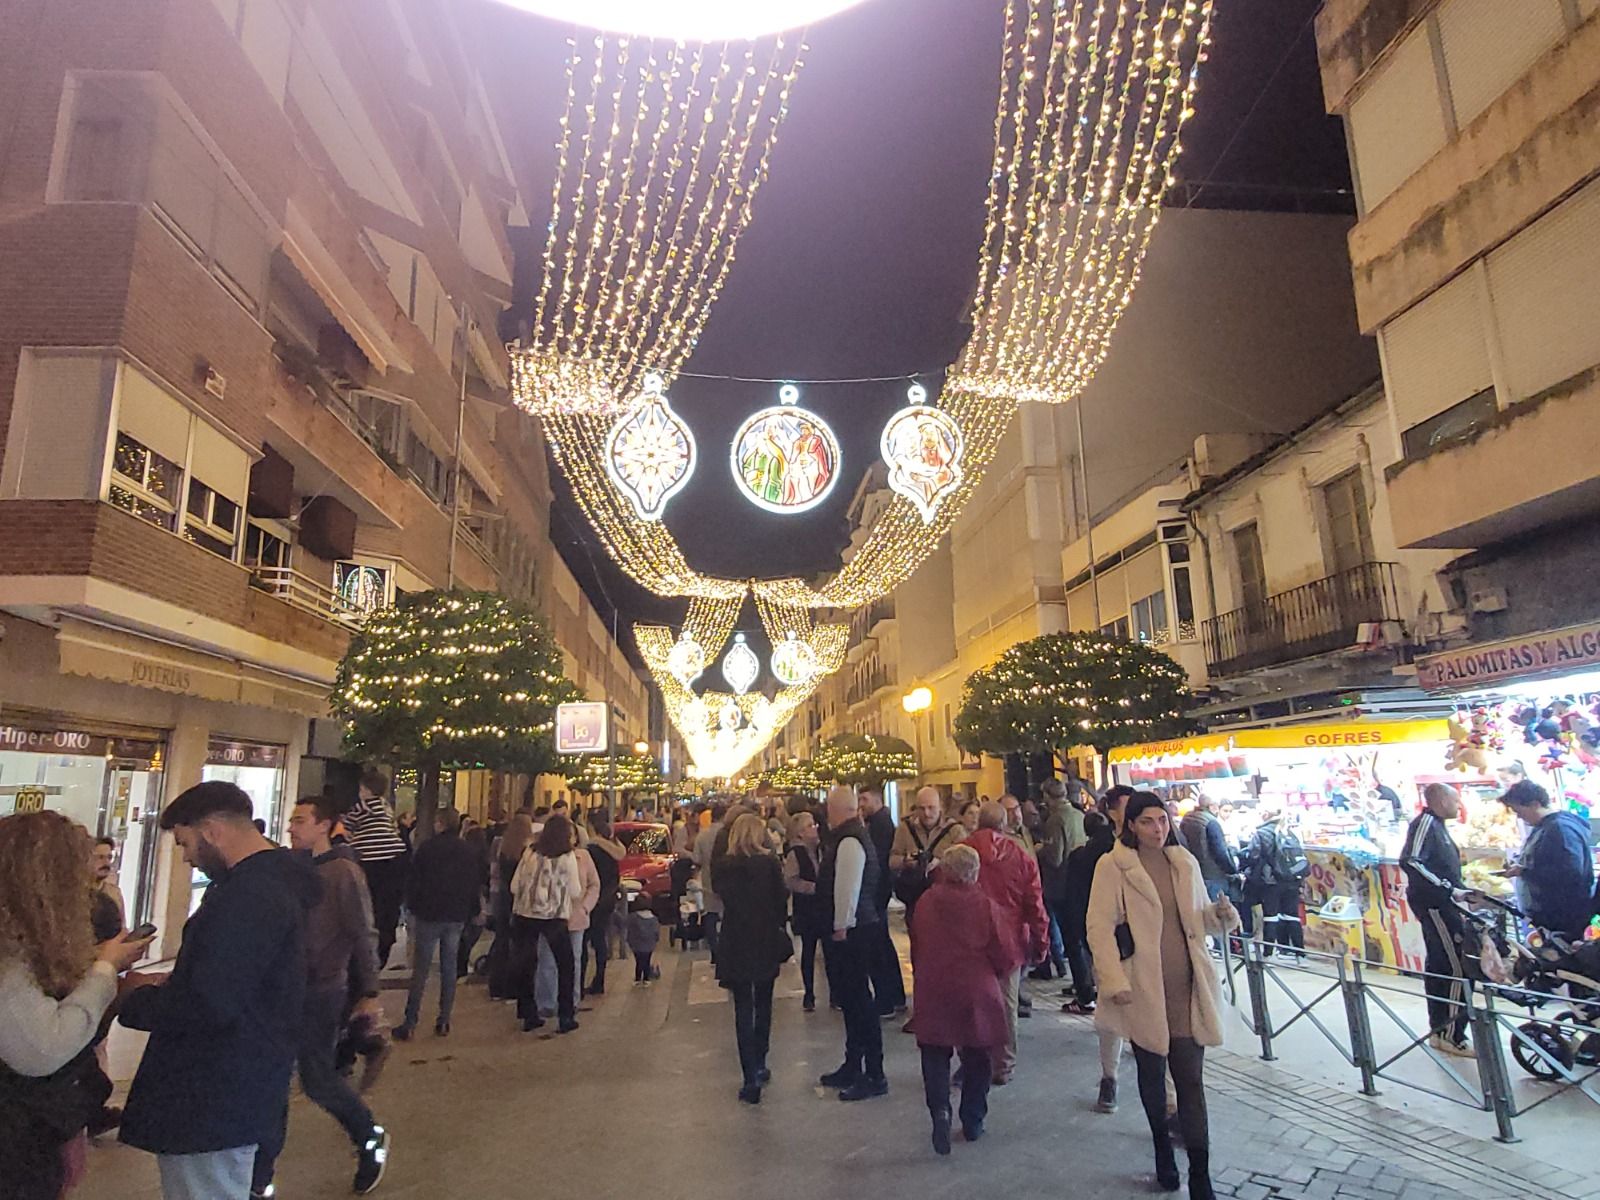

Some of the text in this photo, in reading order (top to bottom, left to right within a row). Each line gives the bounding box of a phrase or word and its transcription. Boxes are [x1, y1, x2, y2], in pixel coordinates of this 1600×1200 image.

[1436, 643, 1533, 681] PALOMITAS
[1533, 640, 1548, 664] Y
[1304, 731, 1382, 746] GOFRES
[17, 793, 42, 812] ORO
